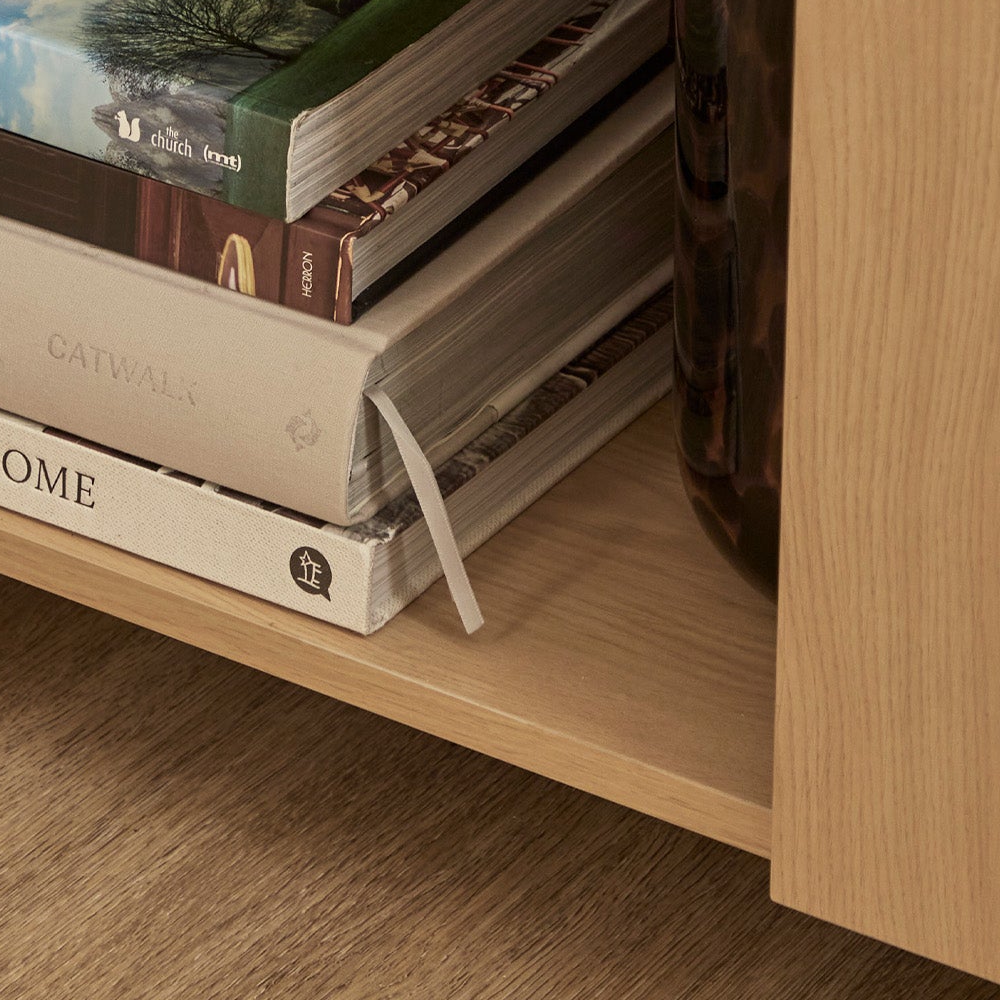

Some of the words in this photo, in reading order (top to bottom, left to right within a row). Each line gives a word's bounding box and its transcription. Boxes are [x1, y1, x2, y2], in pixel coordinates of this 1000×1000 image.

[151, 129, 192, 158] church
[166, 125, 179, 140] the
[301, 250, 314, 298] HERRON
[47, 332, 198, 407] CATWALK
